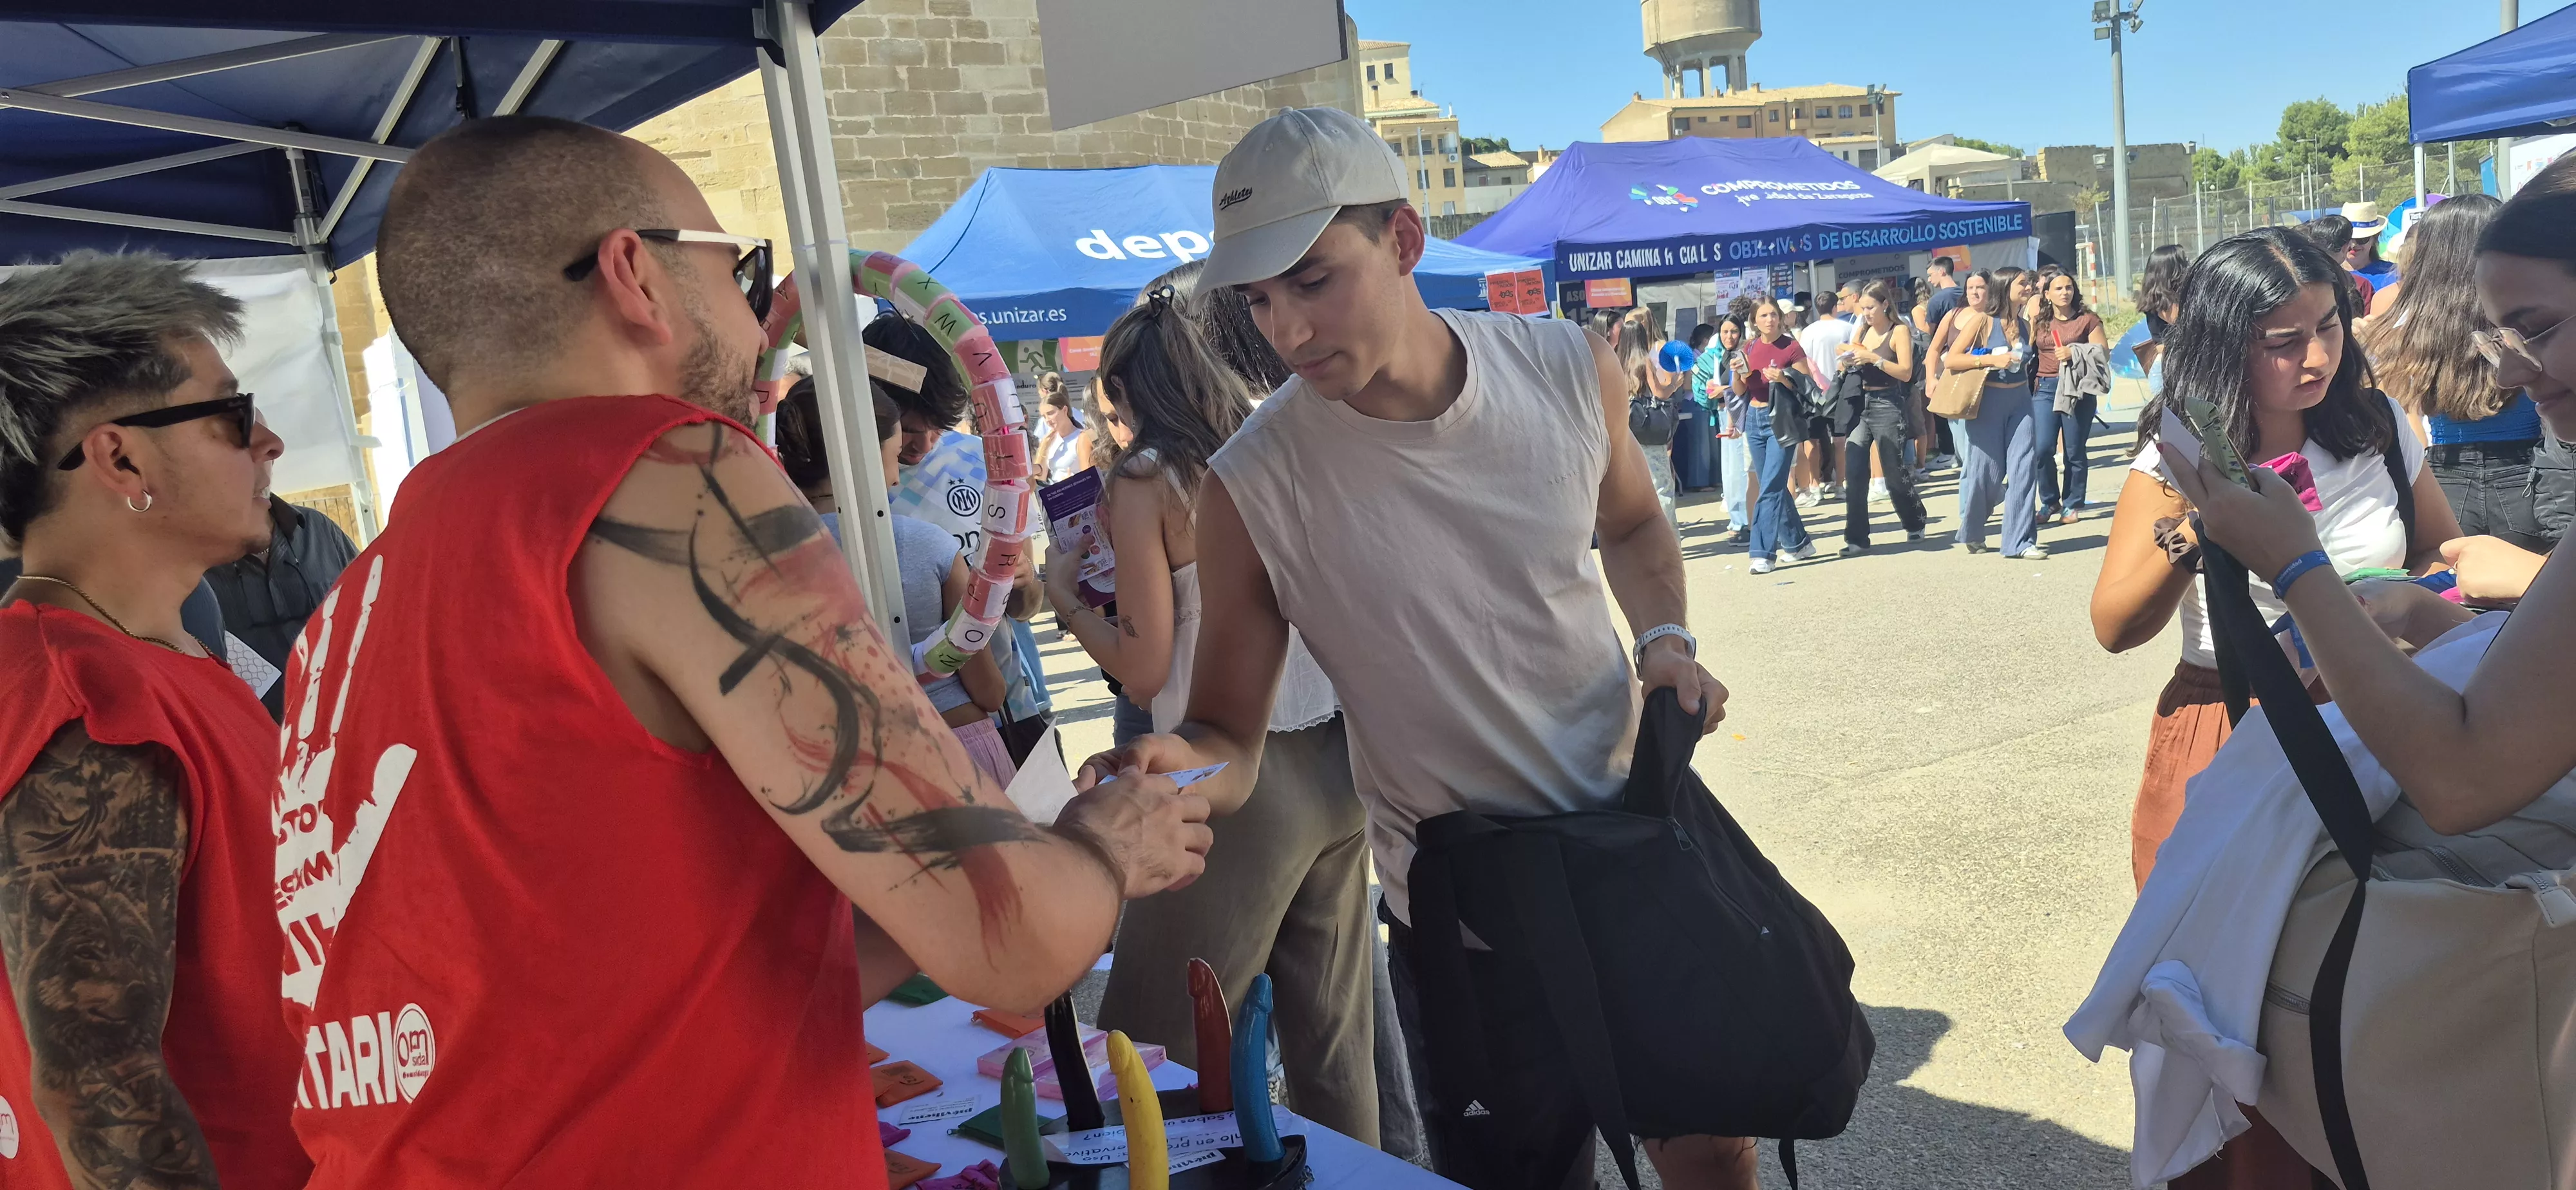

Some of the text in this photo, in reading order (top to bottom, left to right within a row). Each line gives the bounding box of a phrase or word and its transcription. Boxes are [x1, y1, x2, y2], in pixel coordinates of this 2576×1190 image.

[1700, 180, 1861, 195] COMPROMETIDOS
[1075, 229, 1215, 263] dep
[1569, 251, 1613, 272] UNIZAR
[1616, 247, 1662, 269] CAMINA
[1819, 232, 1840, 250] DE
[1842, 223, 1936, 249] DESARROLLO
[1938, 213, 2023, 240] SOSTENIBLE
[1839, 265, 1906, 279] COMPROMETIDOS
[974, 307, 1067, 325] s.unizar.es
[1196, 1137, 1215, 1146] en
